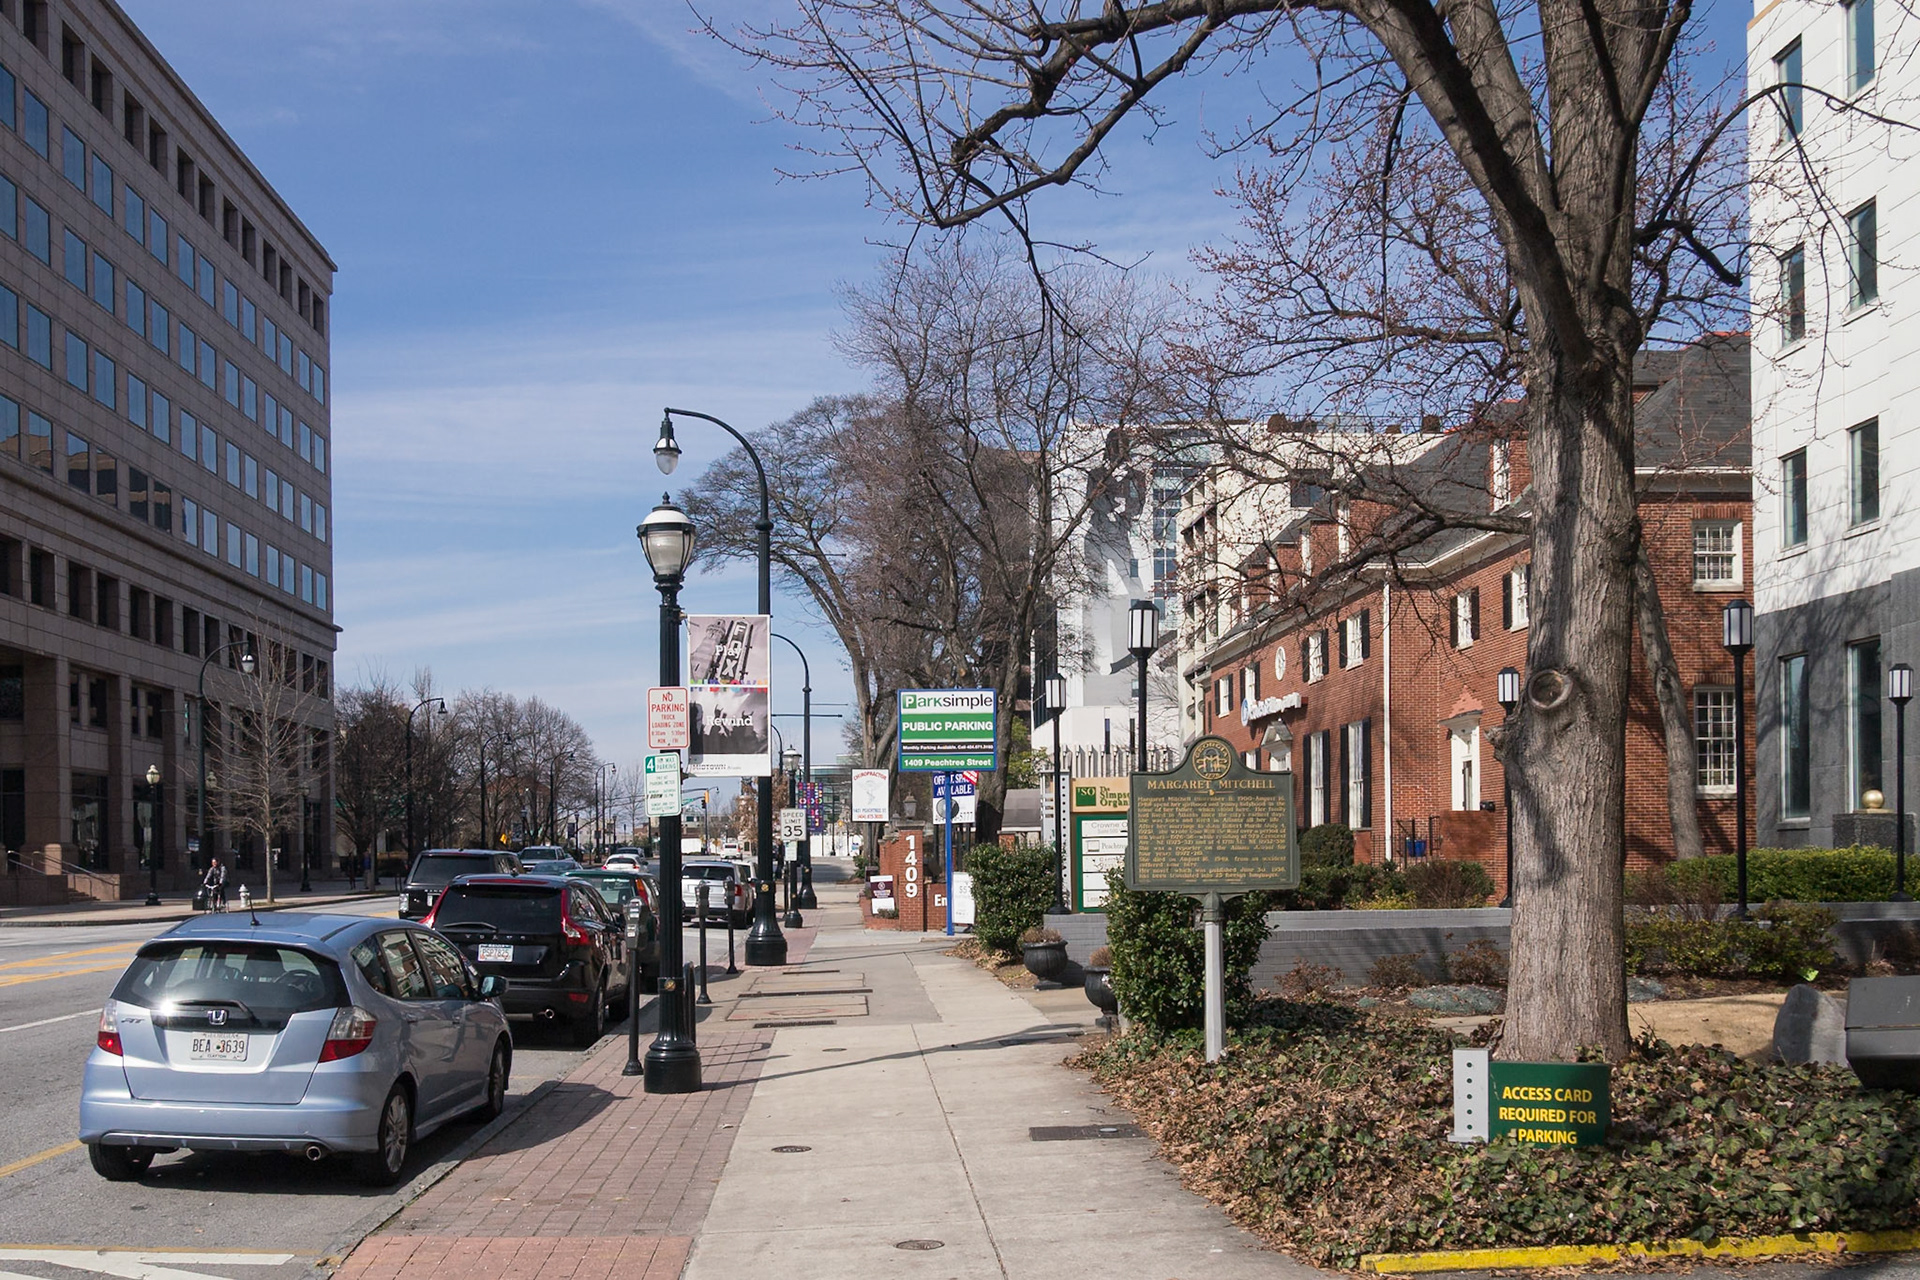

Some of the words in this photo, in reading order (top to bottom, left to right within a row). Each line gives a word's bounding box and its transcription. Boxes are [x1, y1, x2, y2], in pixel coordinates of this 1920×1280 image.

[715, 645, 742, 658] Play
[662, 694, 673, 702] NO
[652, 704, 684, 712] PARKING
[707, 716, 754, 726] Rewind
[903, 722, 942, 731] PUBLIC
[945, 721, 993, 731] PARKING
[647, 758, 655, 771] 4
[904, 759, 924, 767] 1409
[925, 759, 965, 767] Peachtree
[966, 758, 991, 766] Street
[1147, 780, 1211, 790] MARGARET
[1219, 780, 1275, 789] MITCHELL
[1100, 798, 1129, 808] Organ
[784, 826, 803, 837] 35
[904, 835, 918, 898] 1409
[934, 893, 948, 907] En
[192, 1039, 211, 1053] BEA
[219, 1039, 245, 1054] 3639
[1502, 1086, 1552, 1101] ACCESS
[1554, 1088, 1593, 1102] CARD
[1499, 1107, 1567, 1123] REQUIRED
[1569, 1110, 1597, 1124] FOR
[1518, 1128, 1578, 1145] PARKING
